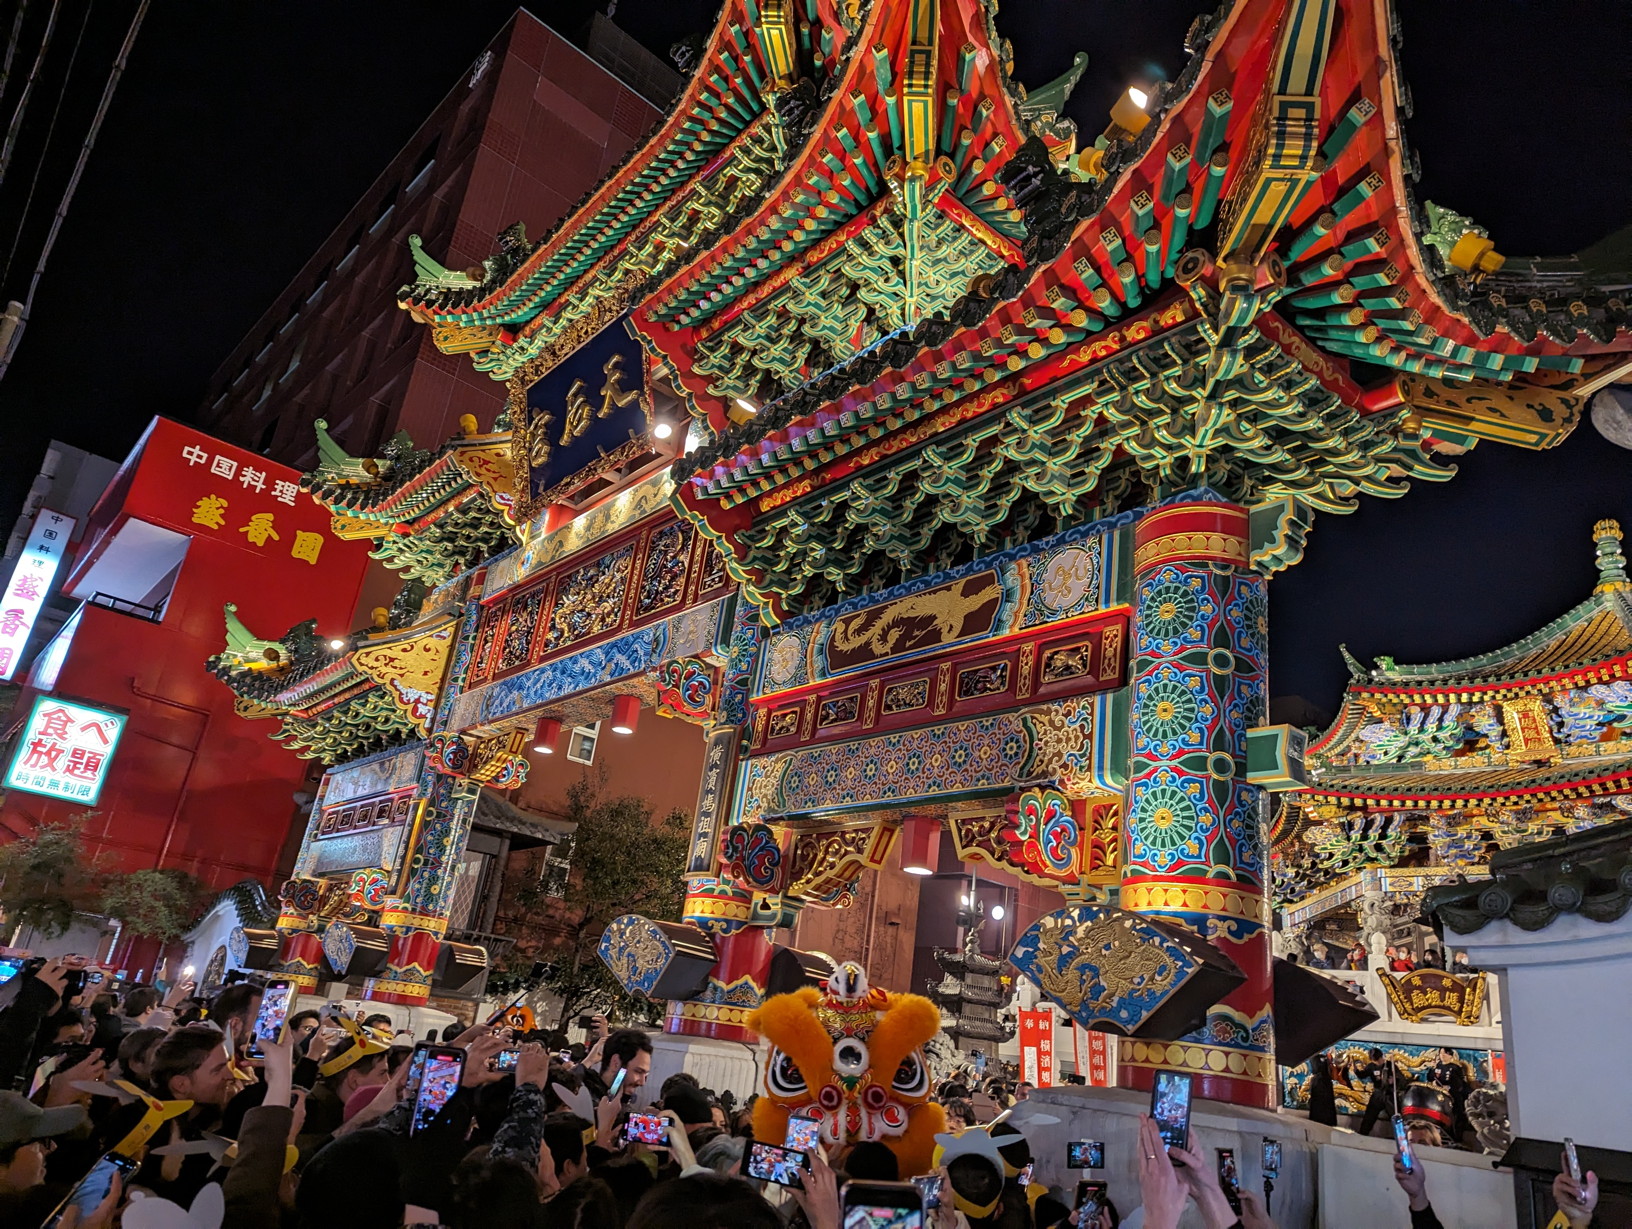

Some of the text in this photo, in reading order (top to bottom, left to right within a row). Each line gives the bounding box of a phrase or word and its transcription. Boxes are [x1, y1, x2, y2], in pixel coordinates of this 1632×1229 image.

[182, 445, 299, 507] 中国料理
[38, 708, 115, 746] 食べ
[23, 738, 104, 781] 放題
[16, 772, 91, 797] 時間無制限
